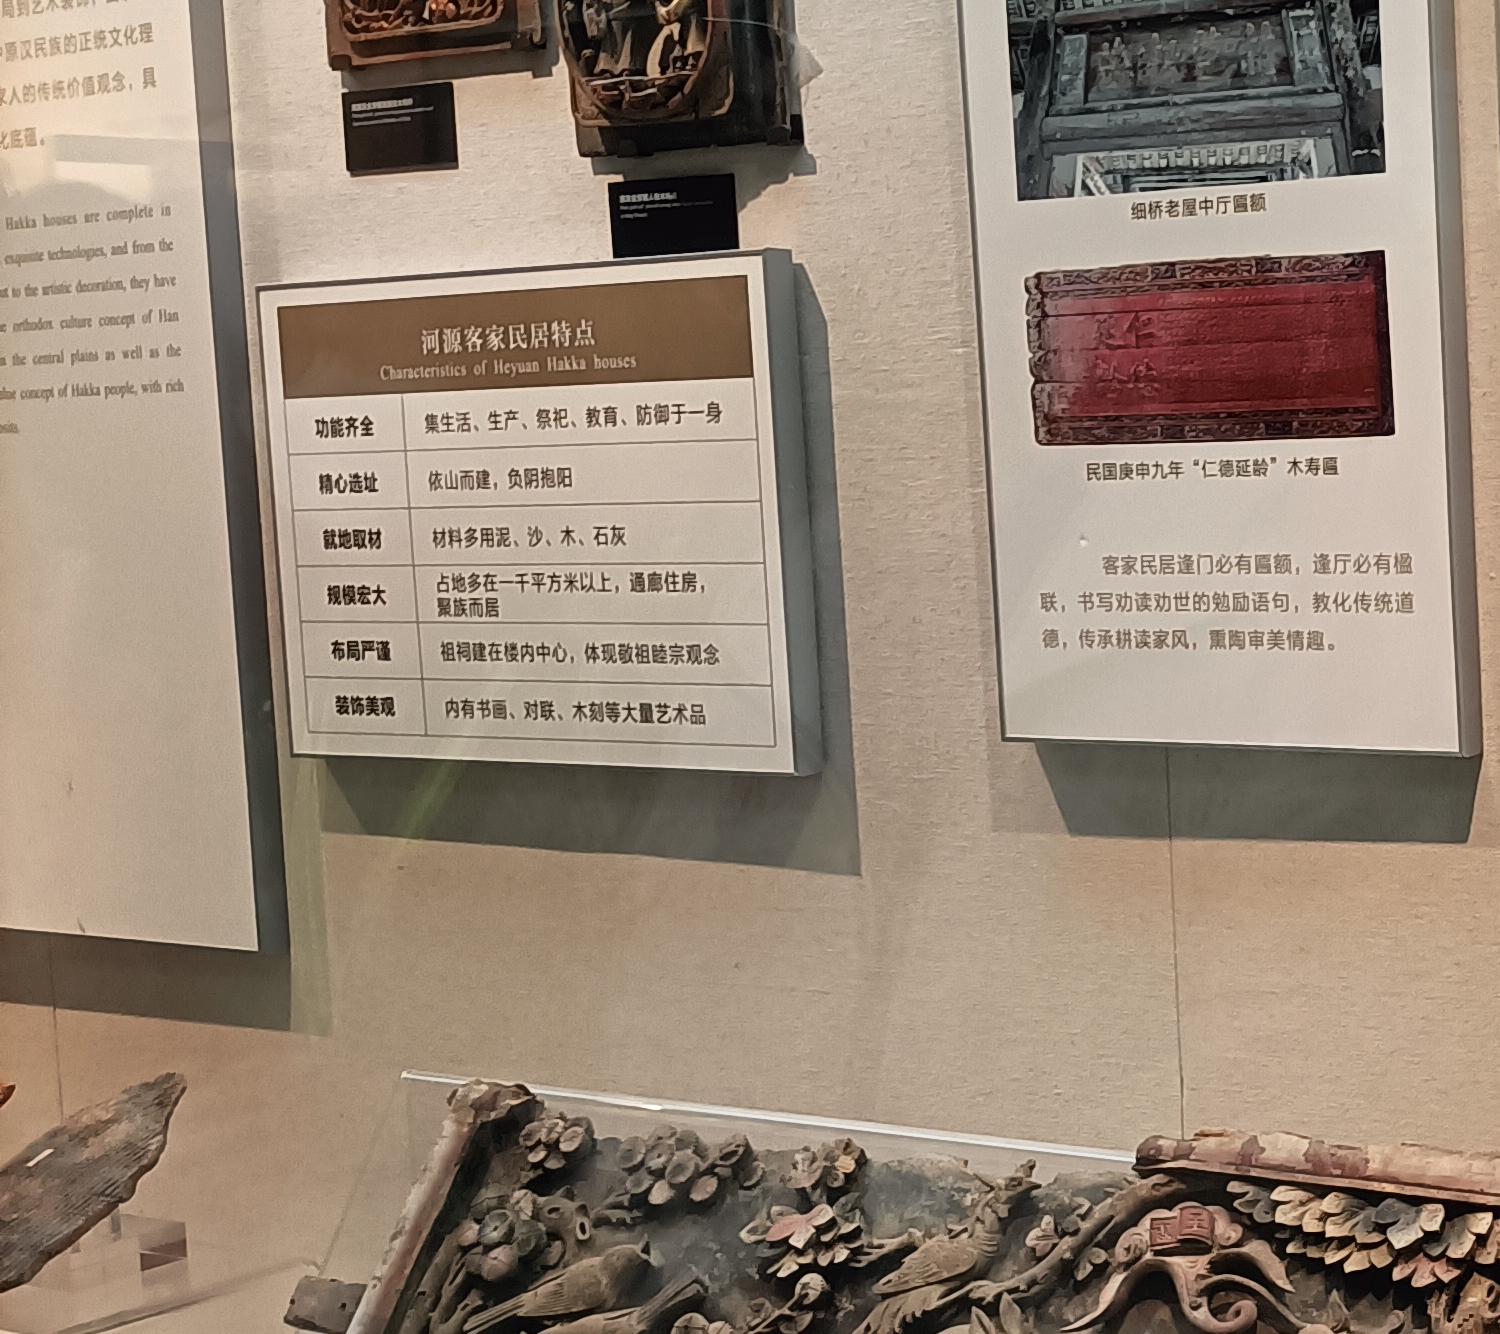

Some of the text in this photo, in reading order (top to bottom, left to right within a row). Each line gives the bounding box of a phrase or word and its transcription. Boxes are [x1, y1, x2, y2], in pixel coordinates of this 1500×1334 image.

[0, 22, 154, 62] 原汉民族的正统文化理
[106, 204, 153, 224] complete
[1130, 192, 1267, 221] 细桥老屋中厅匾额
[421, 319, 597, 355] 河源客家民居特点
[379, 354, 637, 381] Characteristics of Heyuan Hakka houses
[314, 415, 375, 439] 功能齐全
[424, 400, 723, 435] 集生活、生产、祭祀、教育、防御于一身
[318, 471, 379, 495] 精心选址
[428, 466, 573, 492] 依山而建，负阴抱阳
[322, 528, 382, 551] 就地取材
[432, 524, 627, 549] 材料多用泥、沙、木、石灰
[1101, 552, 1414, 576] 客家民居逢门必有匾额，逢厅必有楹
[436, 570, 705, 594] 占地多在一千平方米以上，通廊住房，
[326, 584, 387, 606] 规模宏大
[1039, 590, 1415, 614] 联，书写劝读劝世的勉励语句，教化传统道
[436, 597, 500, 618] 聚族而居
[330, 639, 392, 662] 布局严谨
[1041, 628, 1337, 652] 德，传承耕读家风，熏陶审美情趣。
[439, 641, 720, 666] 祖祠建在楼内中心，体现敬祖睦宗观念
[334, 694, 396, 717] 装饰美观
[444, 698, 707, 725] 内有书画、对联、木刻等大量艺术品
